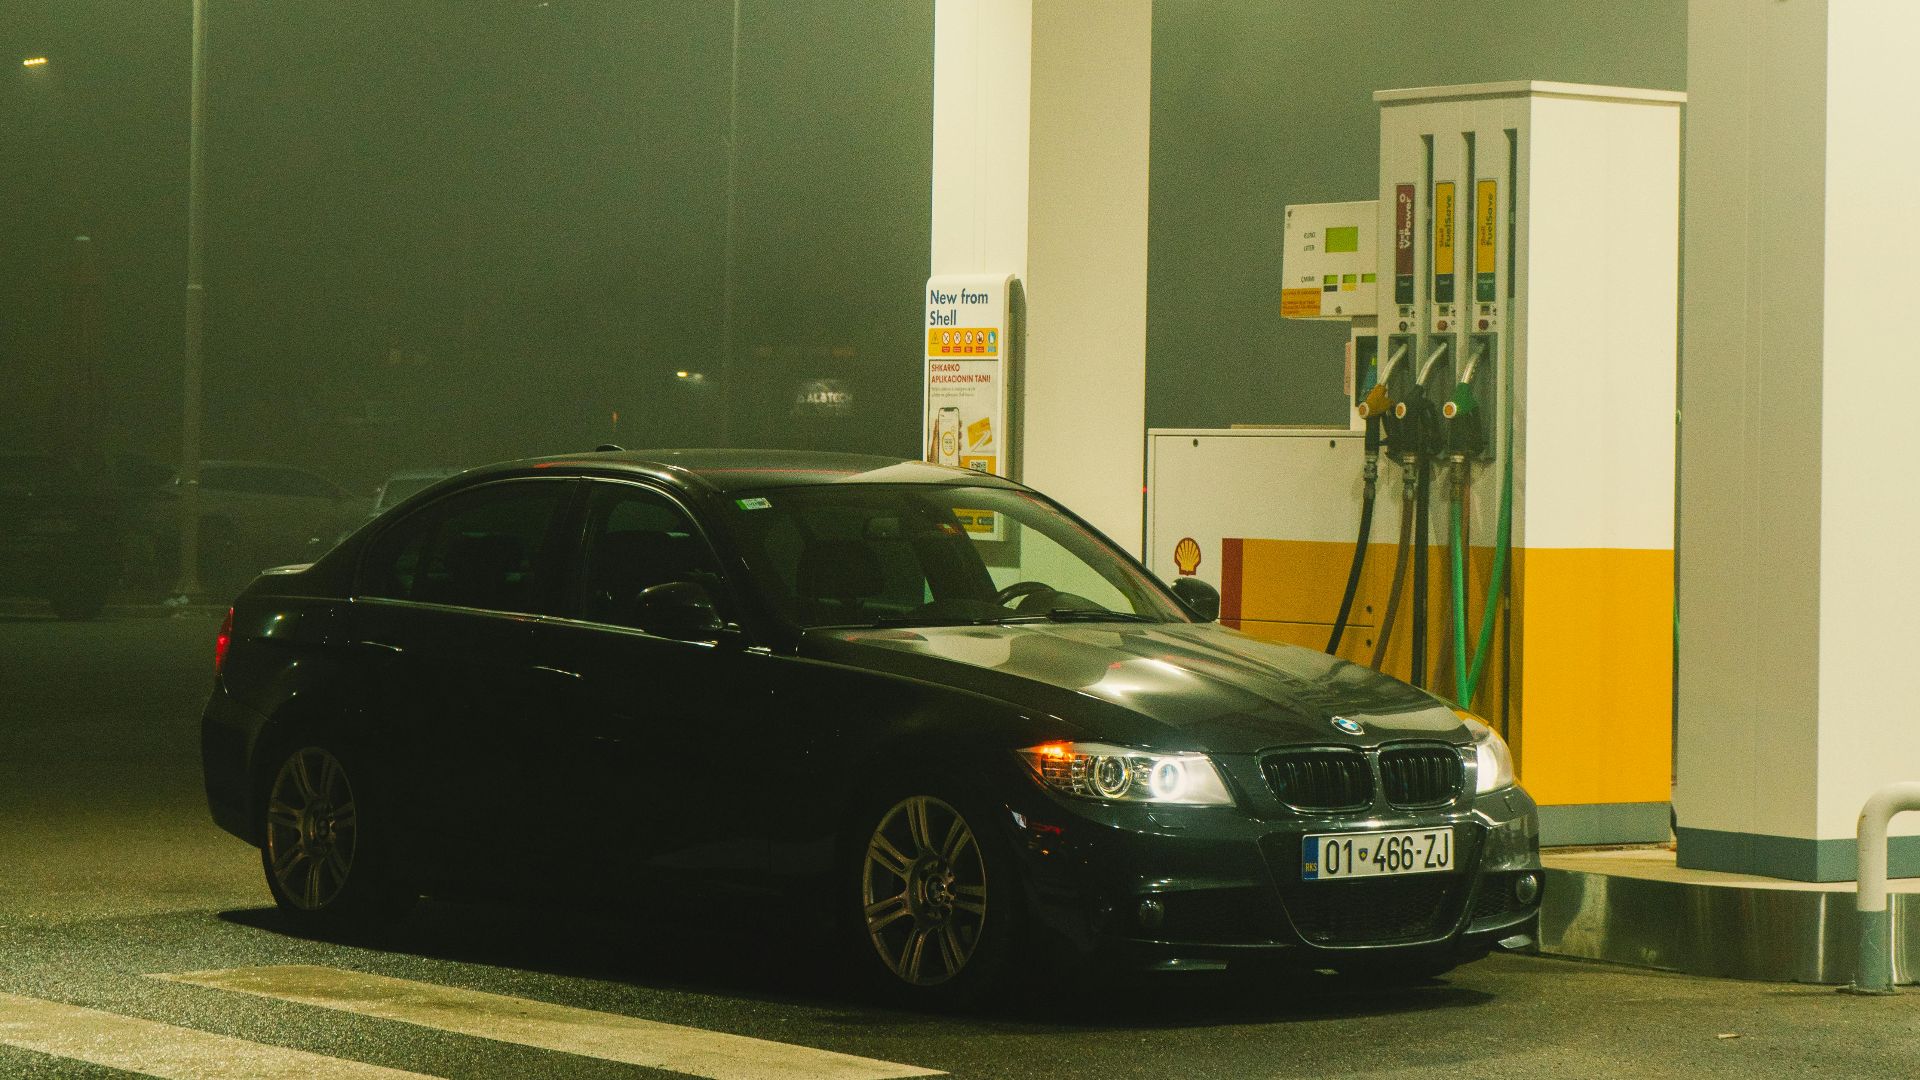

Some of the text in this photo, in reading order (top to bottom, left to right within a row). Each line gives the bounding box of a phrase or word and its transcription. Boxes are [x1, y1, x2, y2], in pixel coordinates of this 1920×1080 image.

[1404, 198, 1412, 249] V-Power
[1486, 193, 1494, 246] FuelSave
[930, 288, 989, 305] New from
[929, 309, 957, 326] Shell
[931, 363, 960, 372] SHKARKO
[931, 374, 974, 383] APLIKACIONIN
[1325, 832, 1449, 875] 01 466-ZJ
[1304, 862, 1317, 872] RKS
